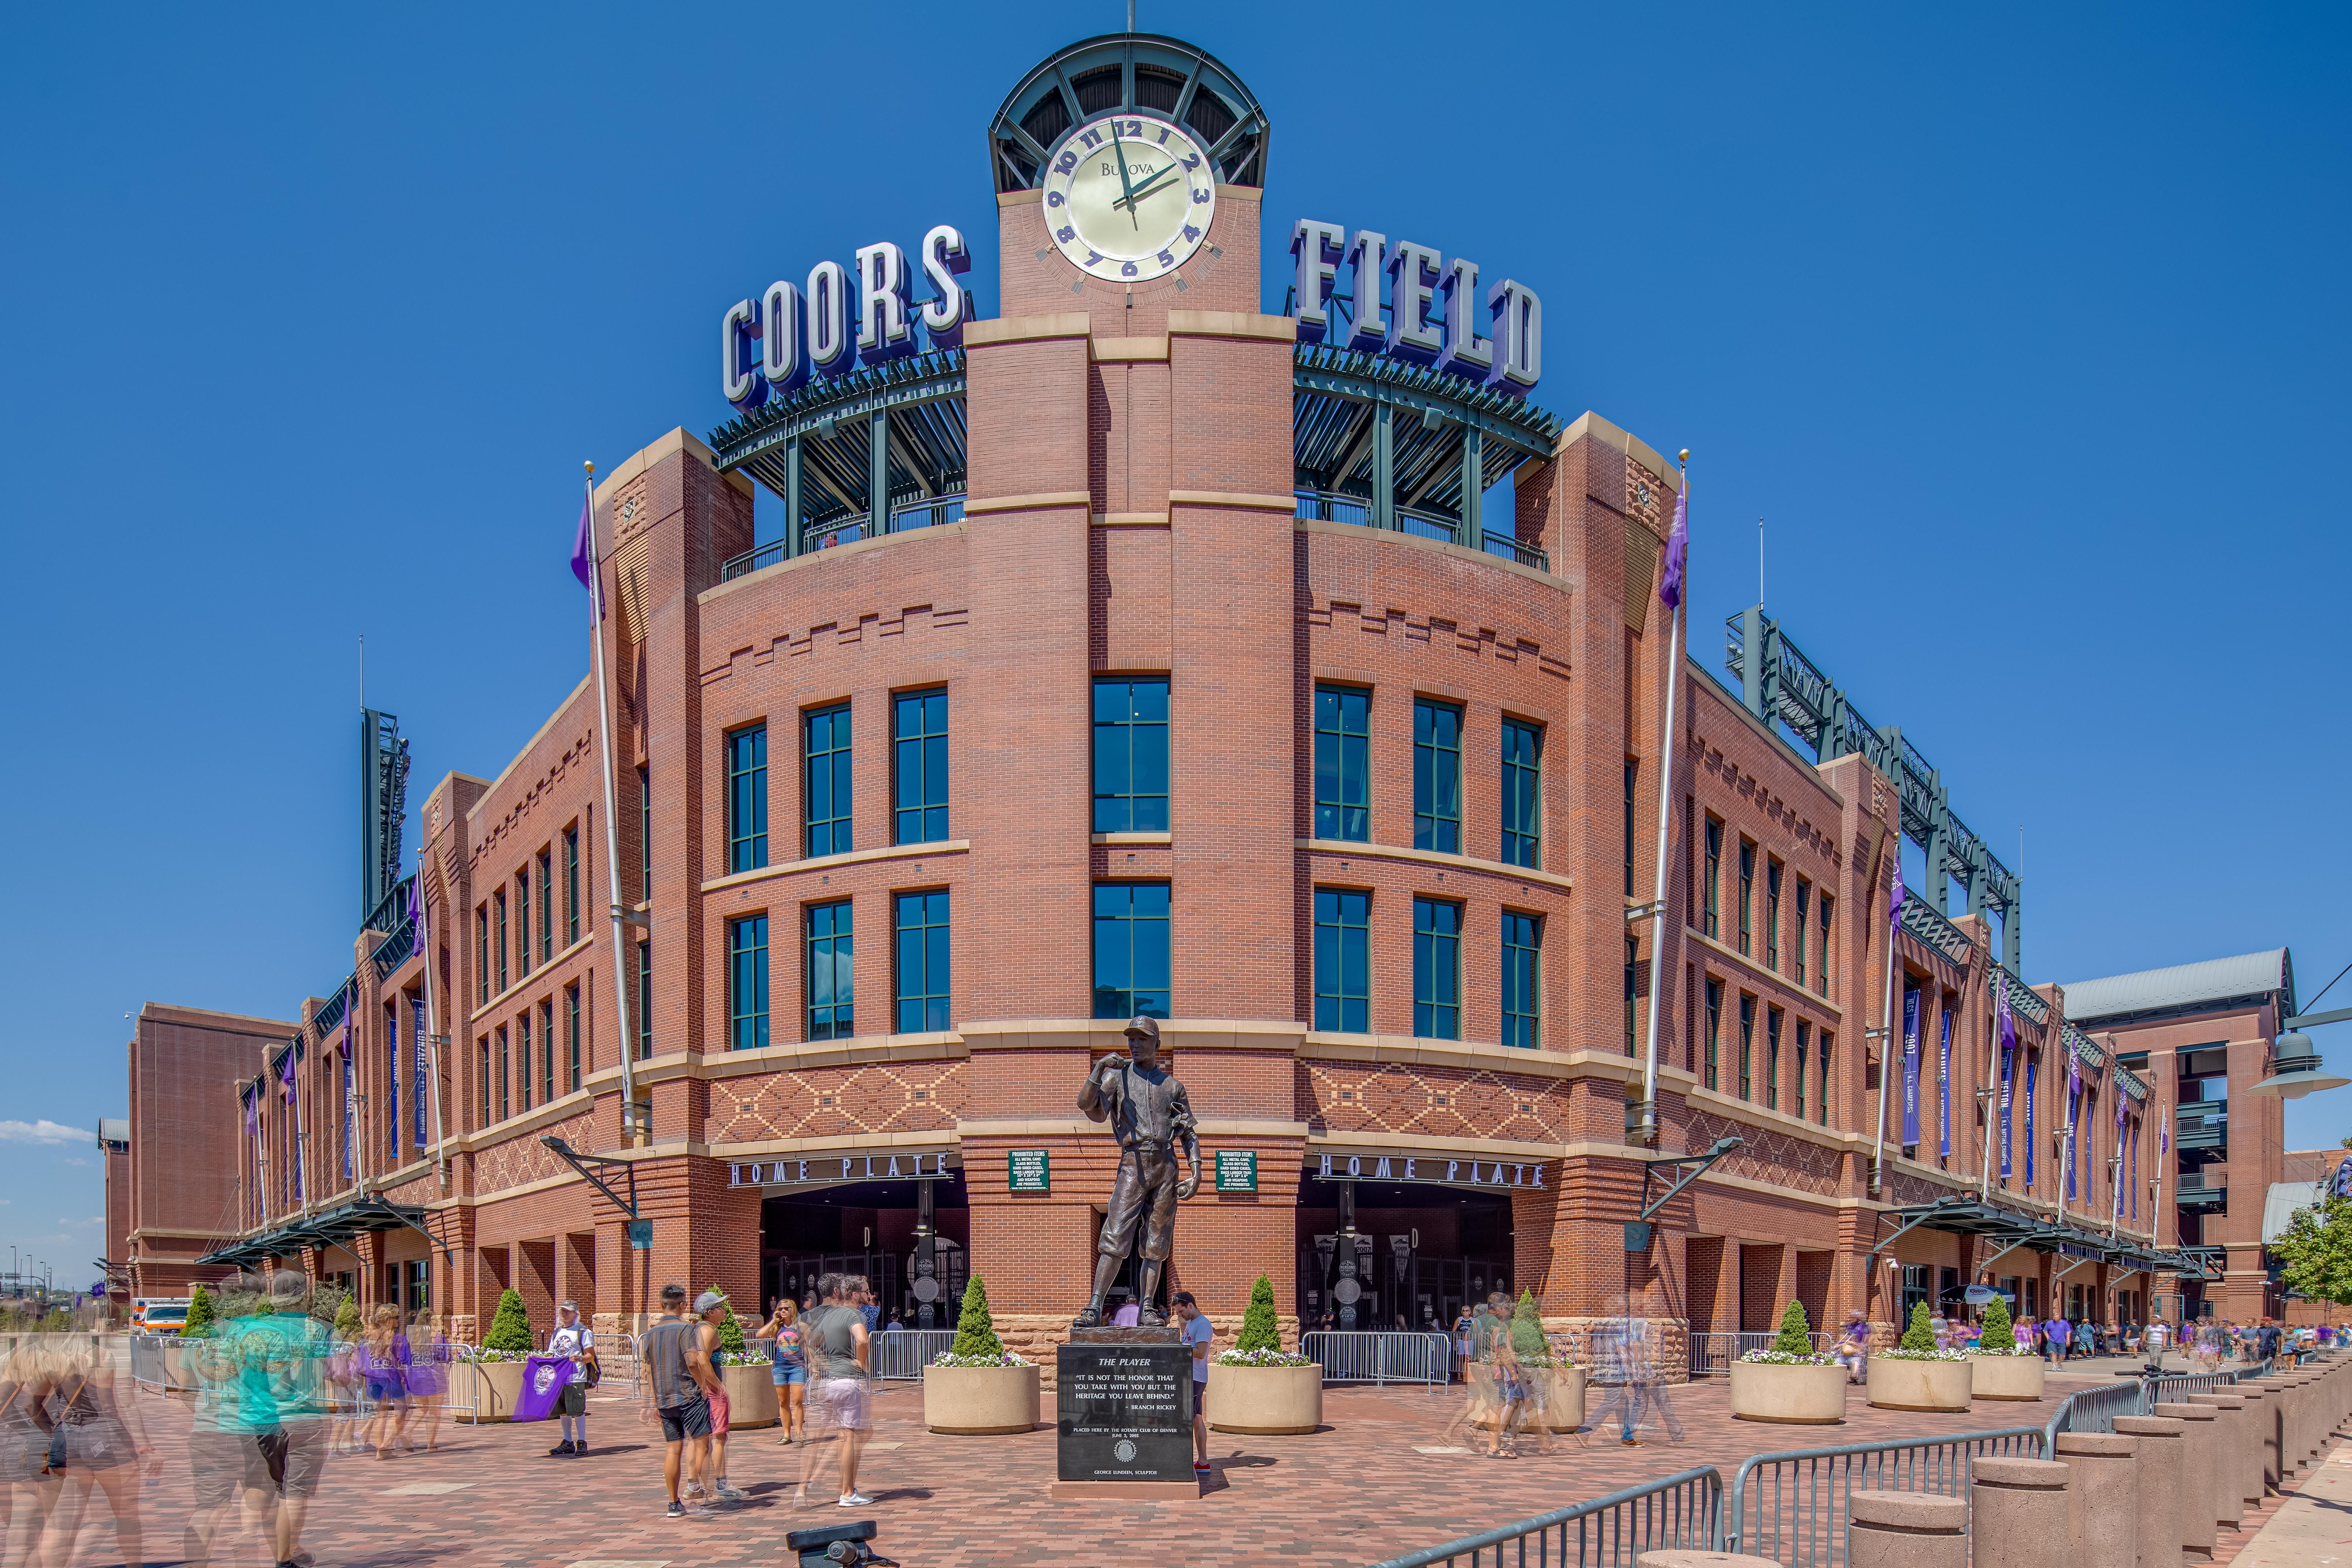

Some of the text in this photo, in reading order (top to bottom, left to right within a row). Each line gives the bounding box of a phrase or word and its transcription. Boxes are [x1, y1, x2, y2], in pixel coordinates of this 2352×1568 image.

[1080, 128, 1103, 149] 11
[1115, 121, 1142, 137] 12
[1158, 128, 1171, 145] 1
[1054, 151, 1078, 176] 10
[1101, 163, 1155, 177] BUOVA
[1180, 153, 1200, 173] 2
[1048, 192, 1065, 208] 9
[1193, 188, 1210, 204] 3
[1056, 225, 1075, 244] 8
[1184, 225, 1201, 243] 4
[1084, 250, 1105, 267] 7
[1157, 249, 1174, 268] 5
[1121, 261, 1138, 276] 6
[723, 218, 1541, 408] COORS FIELD
[1905, 1033, 1915, 1054] 2007
[731, 1154, 947, 1185] HOME PLATE
[1320, 1155, 1543, 1186] HOME PLATE
[864, 1227, 870, 1247] D
[1412, 1228, 1418, 1248] D
